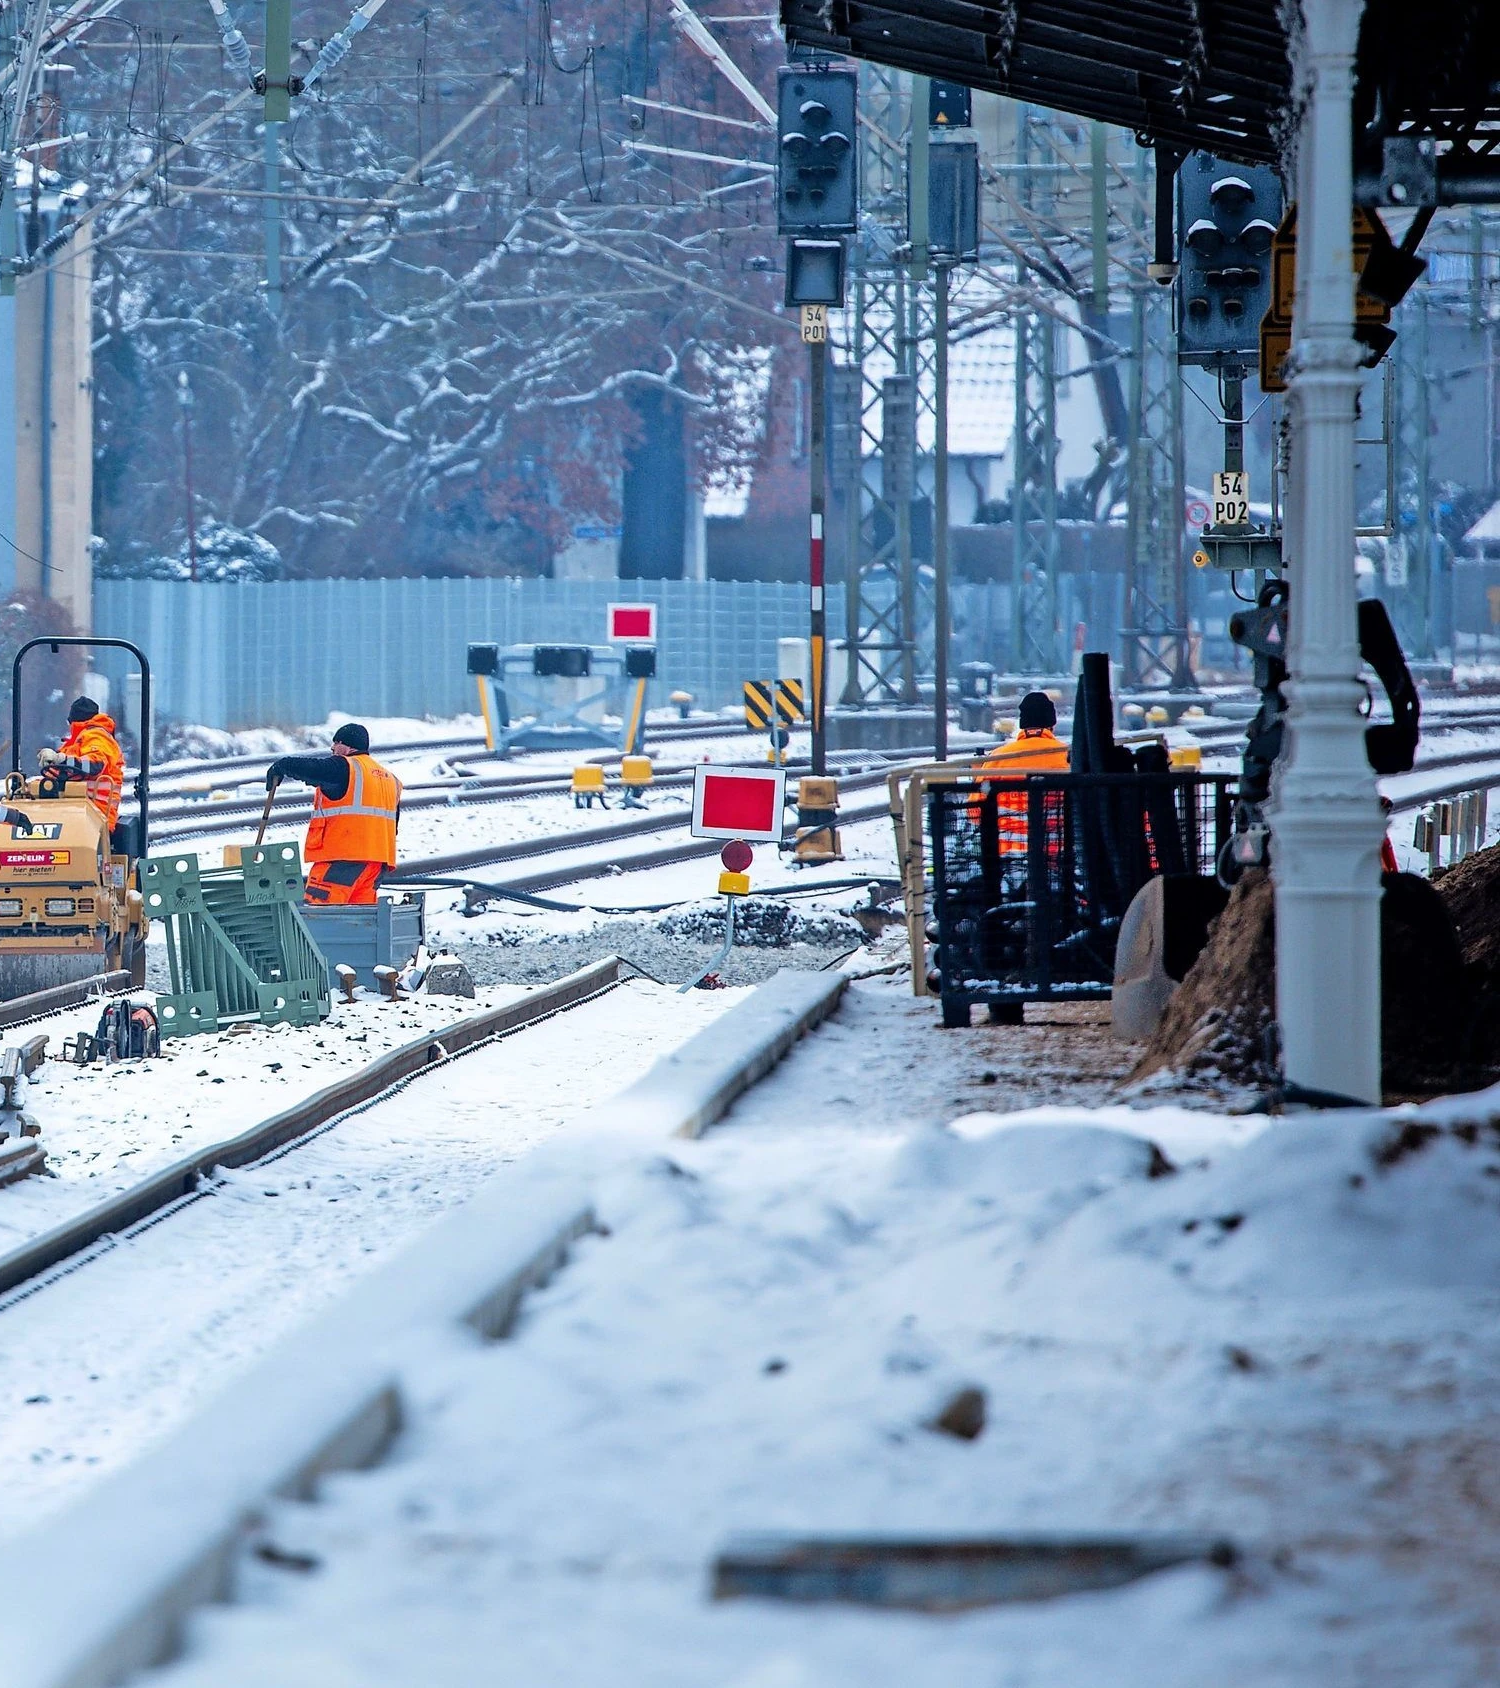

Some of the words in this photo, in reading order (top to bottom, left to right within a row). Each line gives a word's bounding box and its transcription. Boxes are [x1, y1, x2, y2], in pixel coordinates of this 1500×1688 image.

[806, 307, 821, 321] 54
[804, 325, 825, 339] P01
[1220, 476, 1242, 496] 54
[1215, 501, 1247, 521] P02
